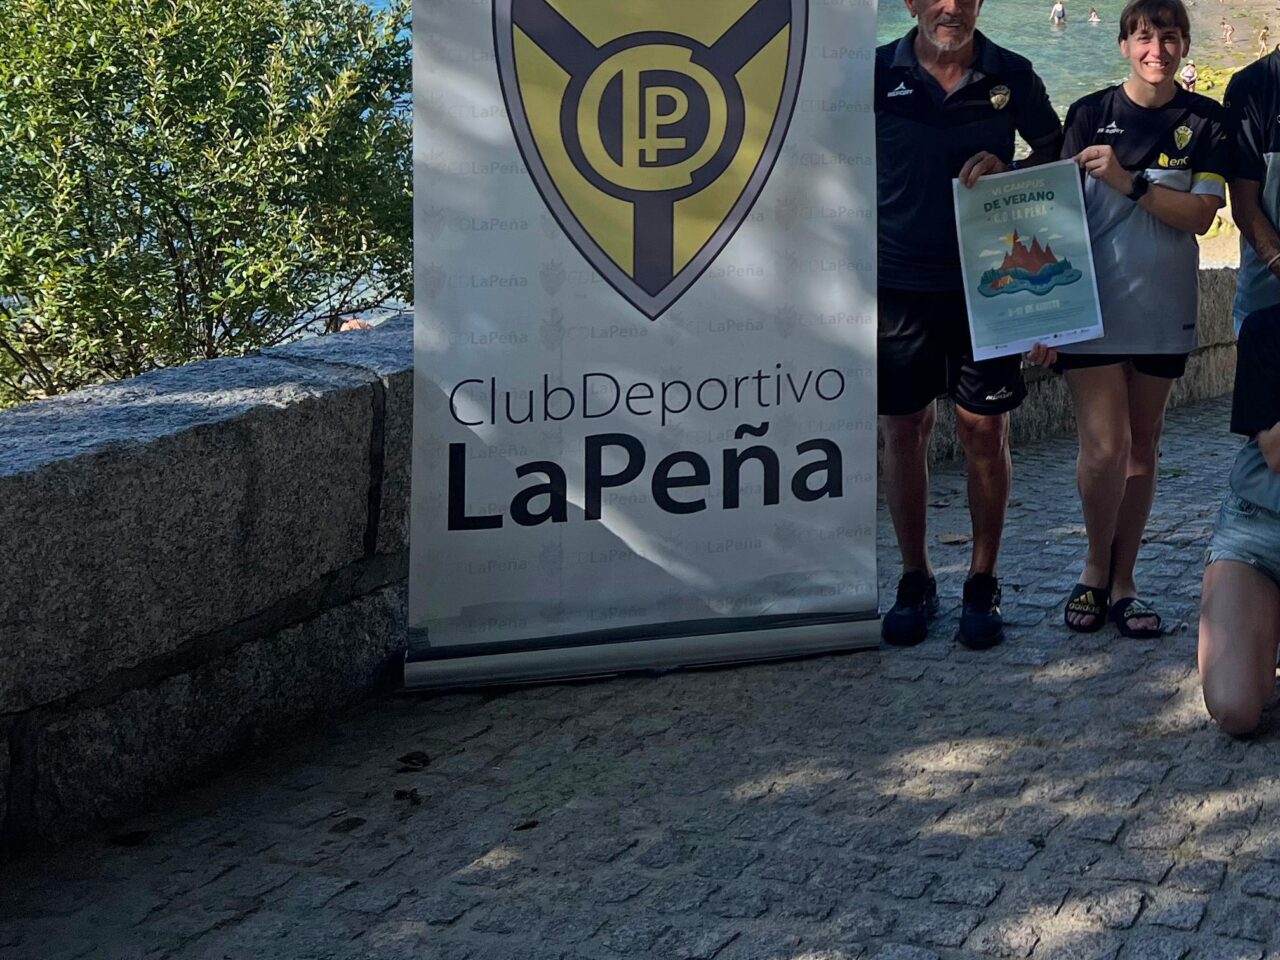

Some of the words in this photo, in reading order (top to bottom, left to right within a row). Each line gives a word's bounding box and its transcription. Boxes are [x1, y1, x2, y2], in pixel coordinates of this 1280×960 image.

[984, 200, 1001, 213] DE
[1002, 190, 1055, 206] VERANO
[1003, 179, 1046, 193] CAMPUS
[448, 362, 846, 426] ClubDeportivo
[447, 421, 844, 532] LaPeña
